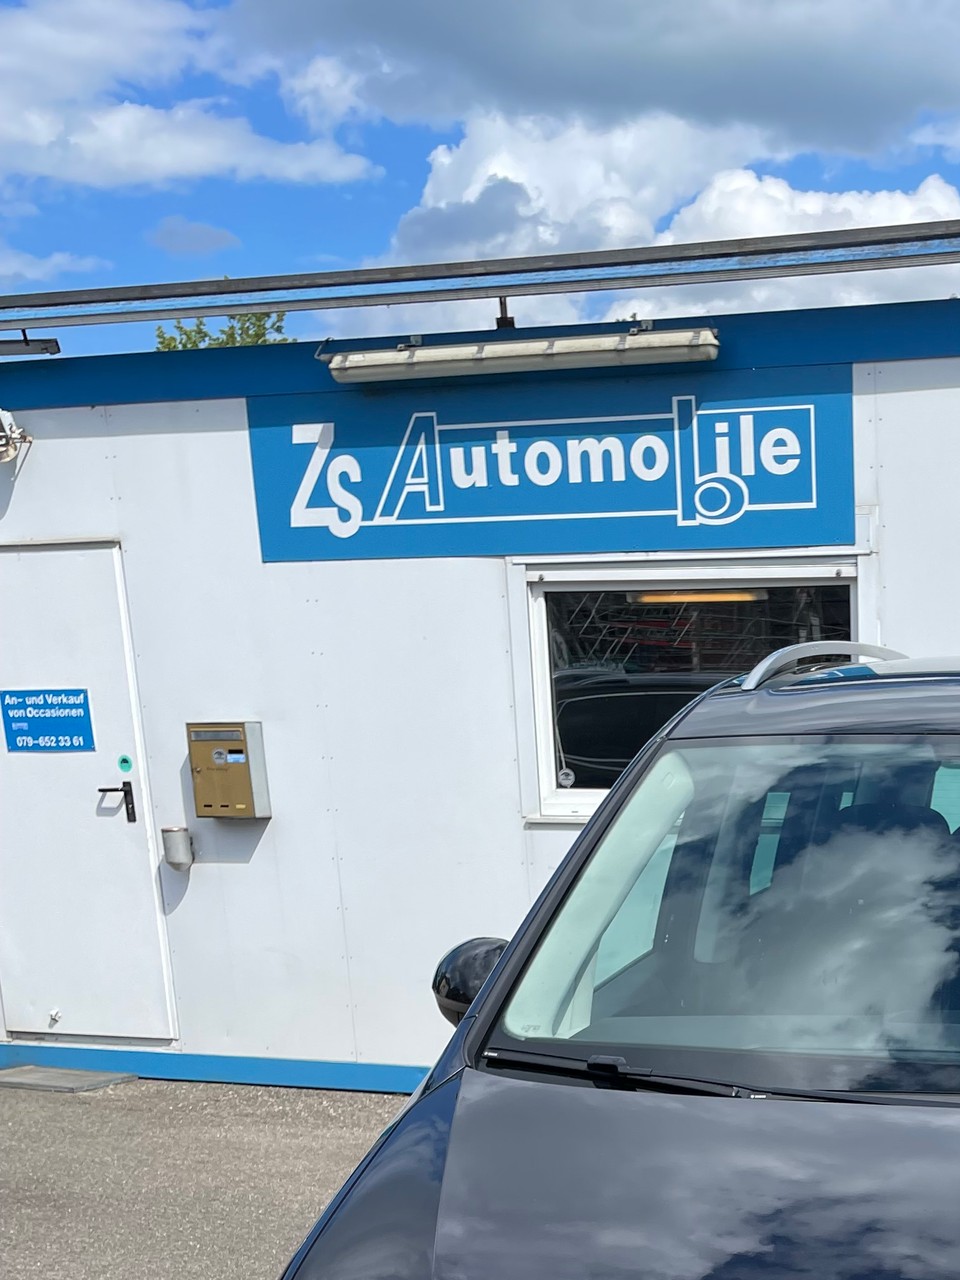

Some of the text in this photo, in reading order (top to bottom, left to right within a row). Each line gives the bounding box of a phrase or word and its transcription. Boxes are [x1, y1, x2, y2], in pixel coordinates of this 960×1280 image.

[372, 395, 801, 526] Automobile
[4, 693, 84, 705] An- und Verkauf
[8, 706, 84, 718] von Occasionen
[16, 735, 84, 747] 079-652 33 61
